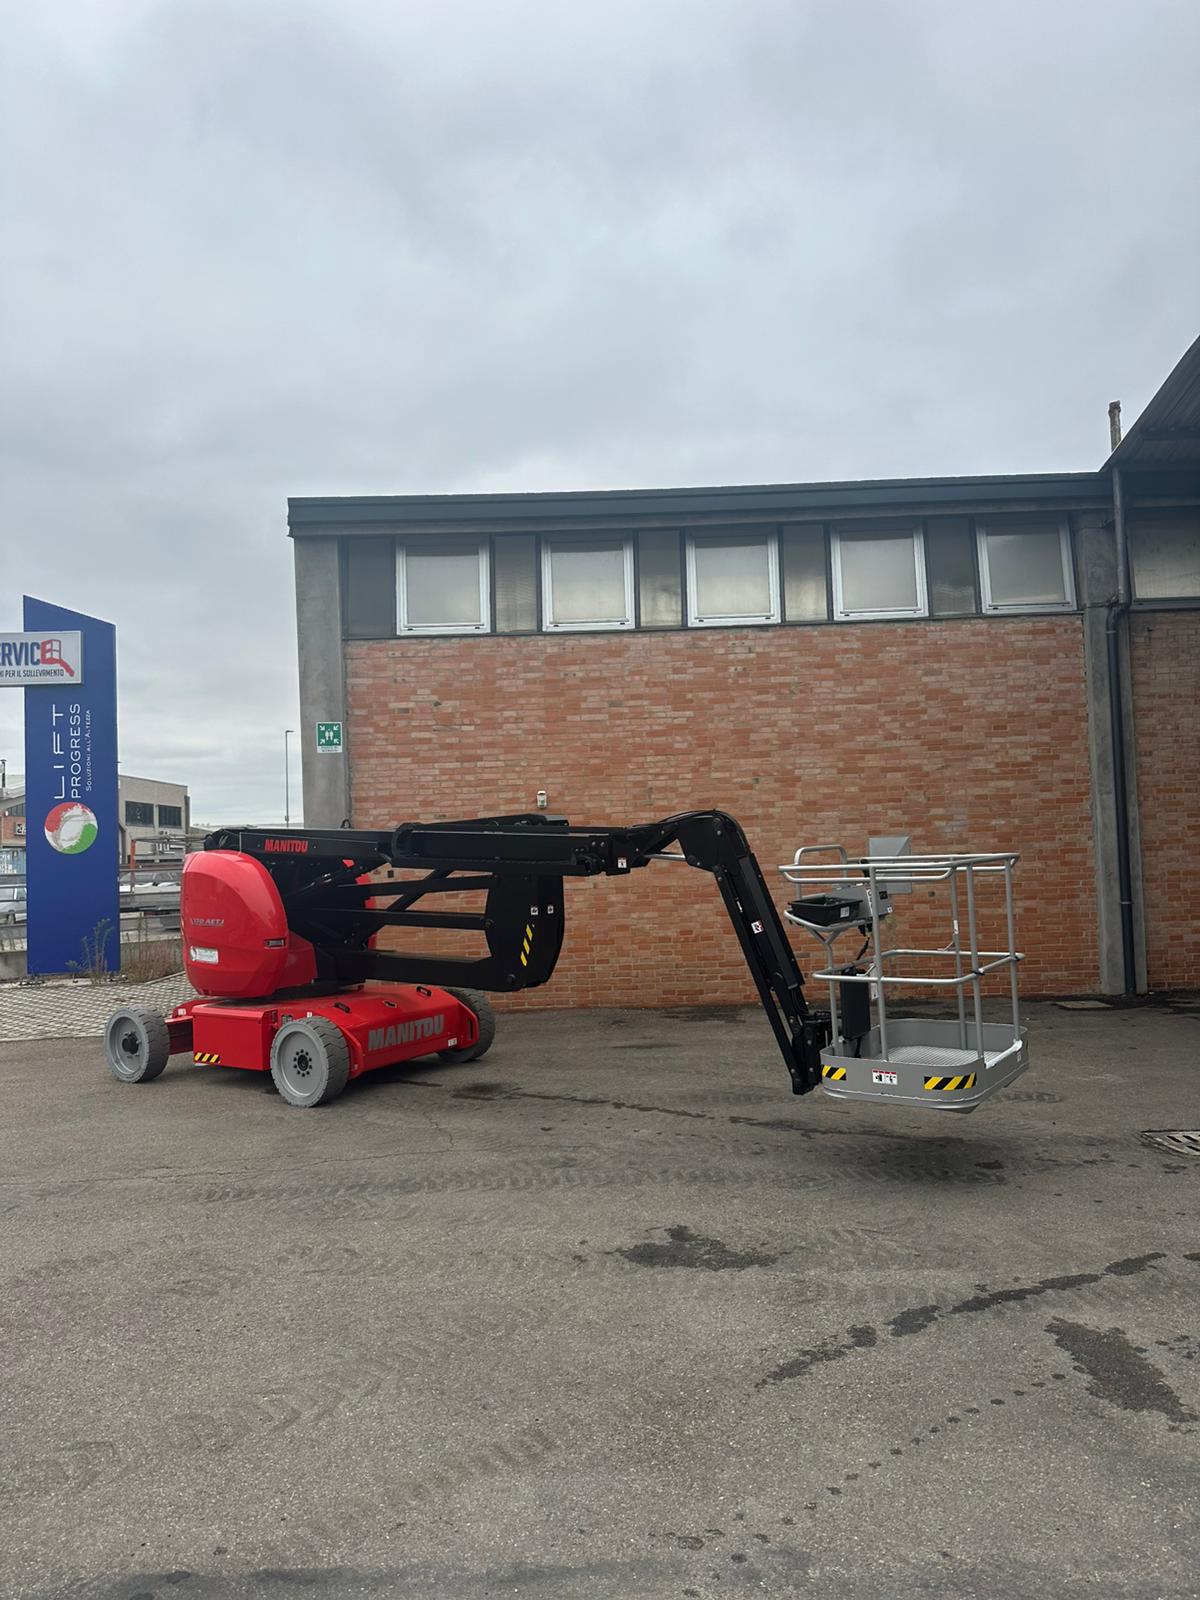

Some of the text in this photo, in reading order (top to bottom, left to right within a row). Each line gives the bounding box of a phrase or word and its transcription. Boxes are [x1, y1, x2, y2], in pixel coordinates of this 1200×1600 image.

[5, 669, 16, 678] PER
[17, 669, 22, 678] IL
[23, 668, 65, 678] SOLLEVAMENTO
[52, 703, 65, 799] LIFT
[69, 703, 81, 799] PROGRESS
[264, 839, 309, 853] MANITOU
[368, 1014, 445, 1051] MANITOU
